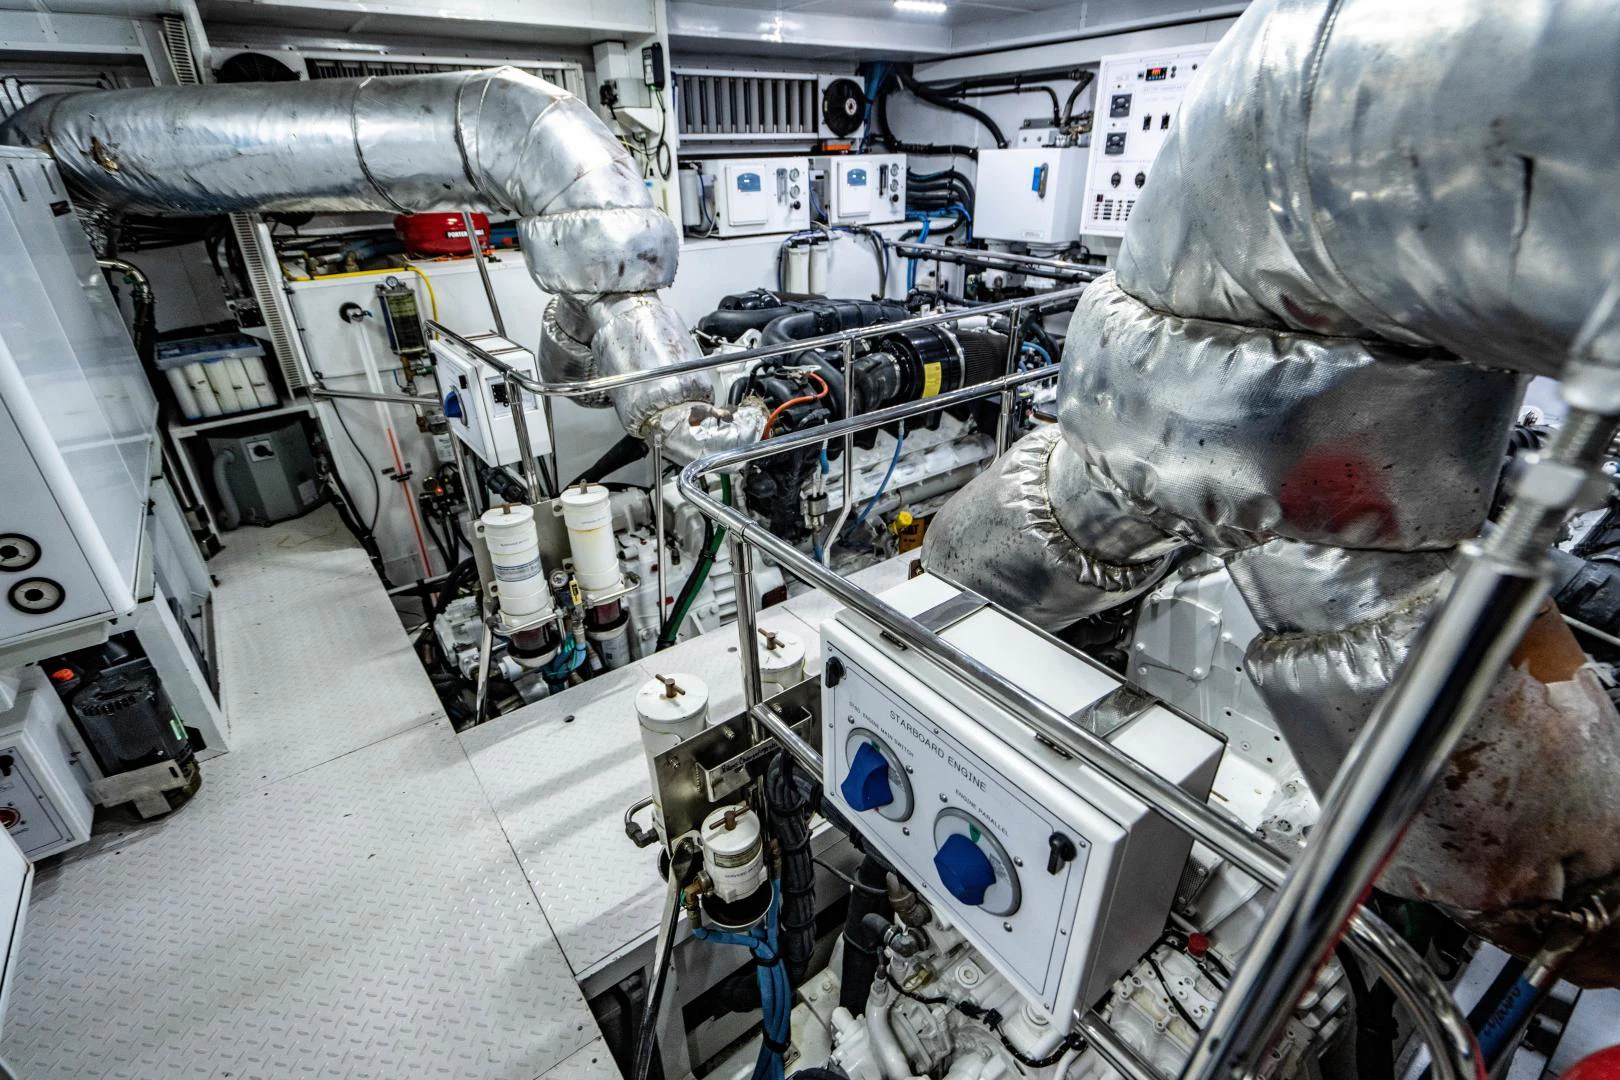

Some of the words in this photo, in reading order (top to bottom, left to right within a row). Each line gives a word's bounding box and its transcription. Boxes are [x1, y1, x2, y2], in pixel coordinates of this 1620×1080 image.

[880, 727, 893, 741] MAIN
[889, 709, 945, 759] STARBOARD
[947, 755, 987, 793] ENGINE
[955, 788, 977, 811] ENGINE
[978, 807, 1009, 838] PARALLEL
